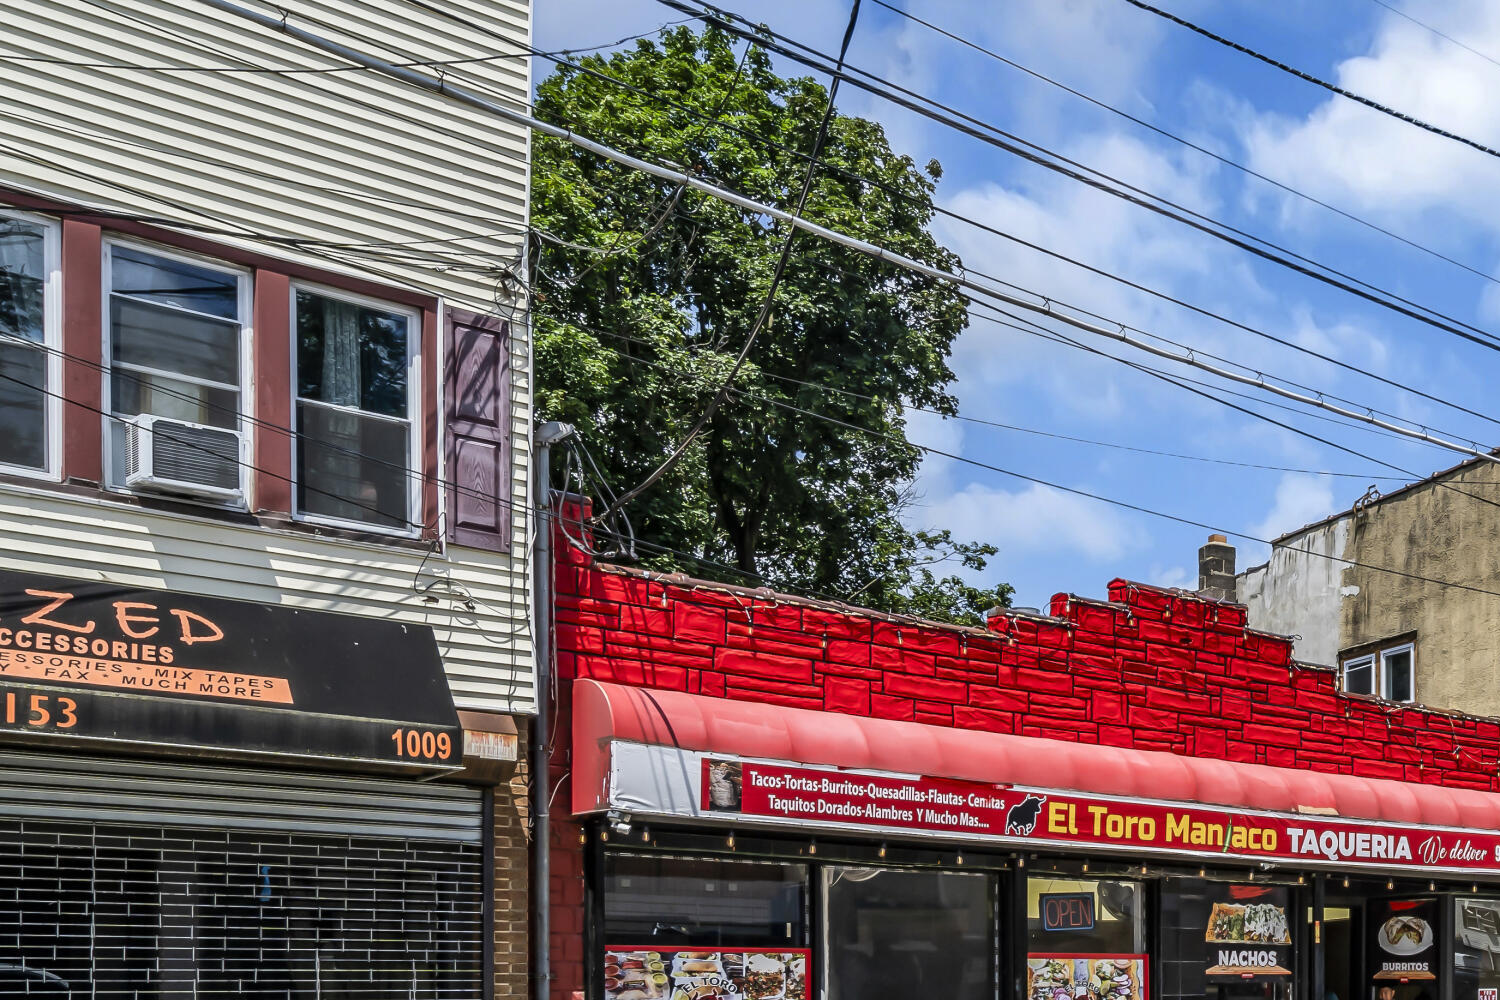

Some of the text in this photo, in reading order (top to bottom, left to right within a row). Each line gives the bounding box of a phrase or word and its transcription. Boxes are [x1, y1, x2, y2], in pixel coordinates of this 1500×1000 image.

[44, 667, 89, 681] FAX
[122, 675, 187, 690] MUCH
[200, 683, 262, 698] MORE
[155, 668, 193, 680] MIX
[205, 673, 275, 689] TAPES
[391, 728, 452, 760] 1009
[768, 794, 816, 814] Taquitos
[916, 808, 924, 822] Y
[925, 808, 958, 825] Mucho
[967, 793, 1005, 810] Cemitas
[1048, 801, 1278, 853] El Toro Maniaco
[1286, 827, 1413, 861] TAQUERIA
[1418, 835, 1448, 864] We
[1449, 839, 1488, 861] deliver
[1046, 898, 1092, 927] OPEN
[1218, 950, 1277, 967] NACHOS
[1382, 962, 1429, 971] BURRITOS
[682, 977, 738, 993] EL TORO
[1075, 981, 1100, 993] TORO
